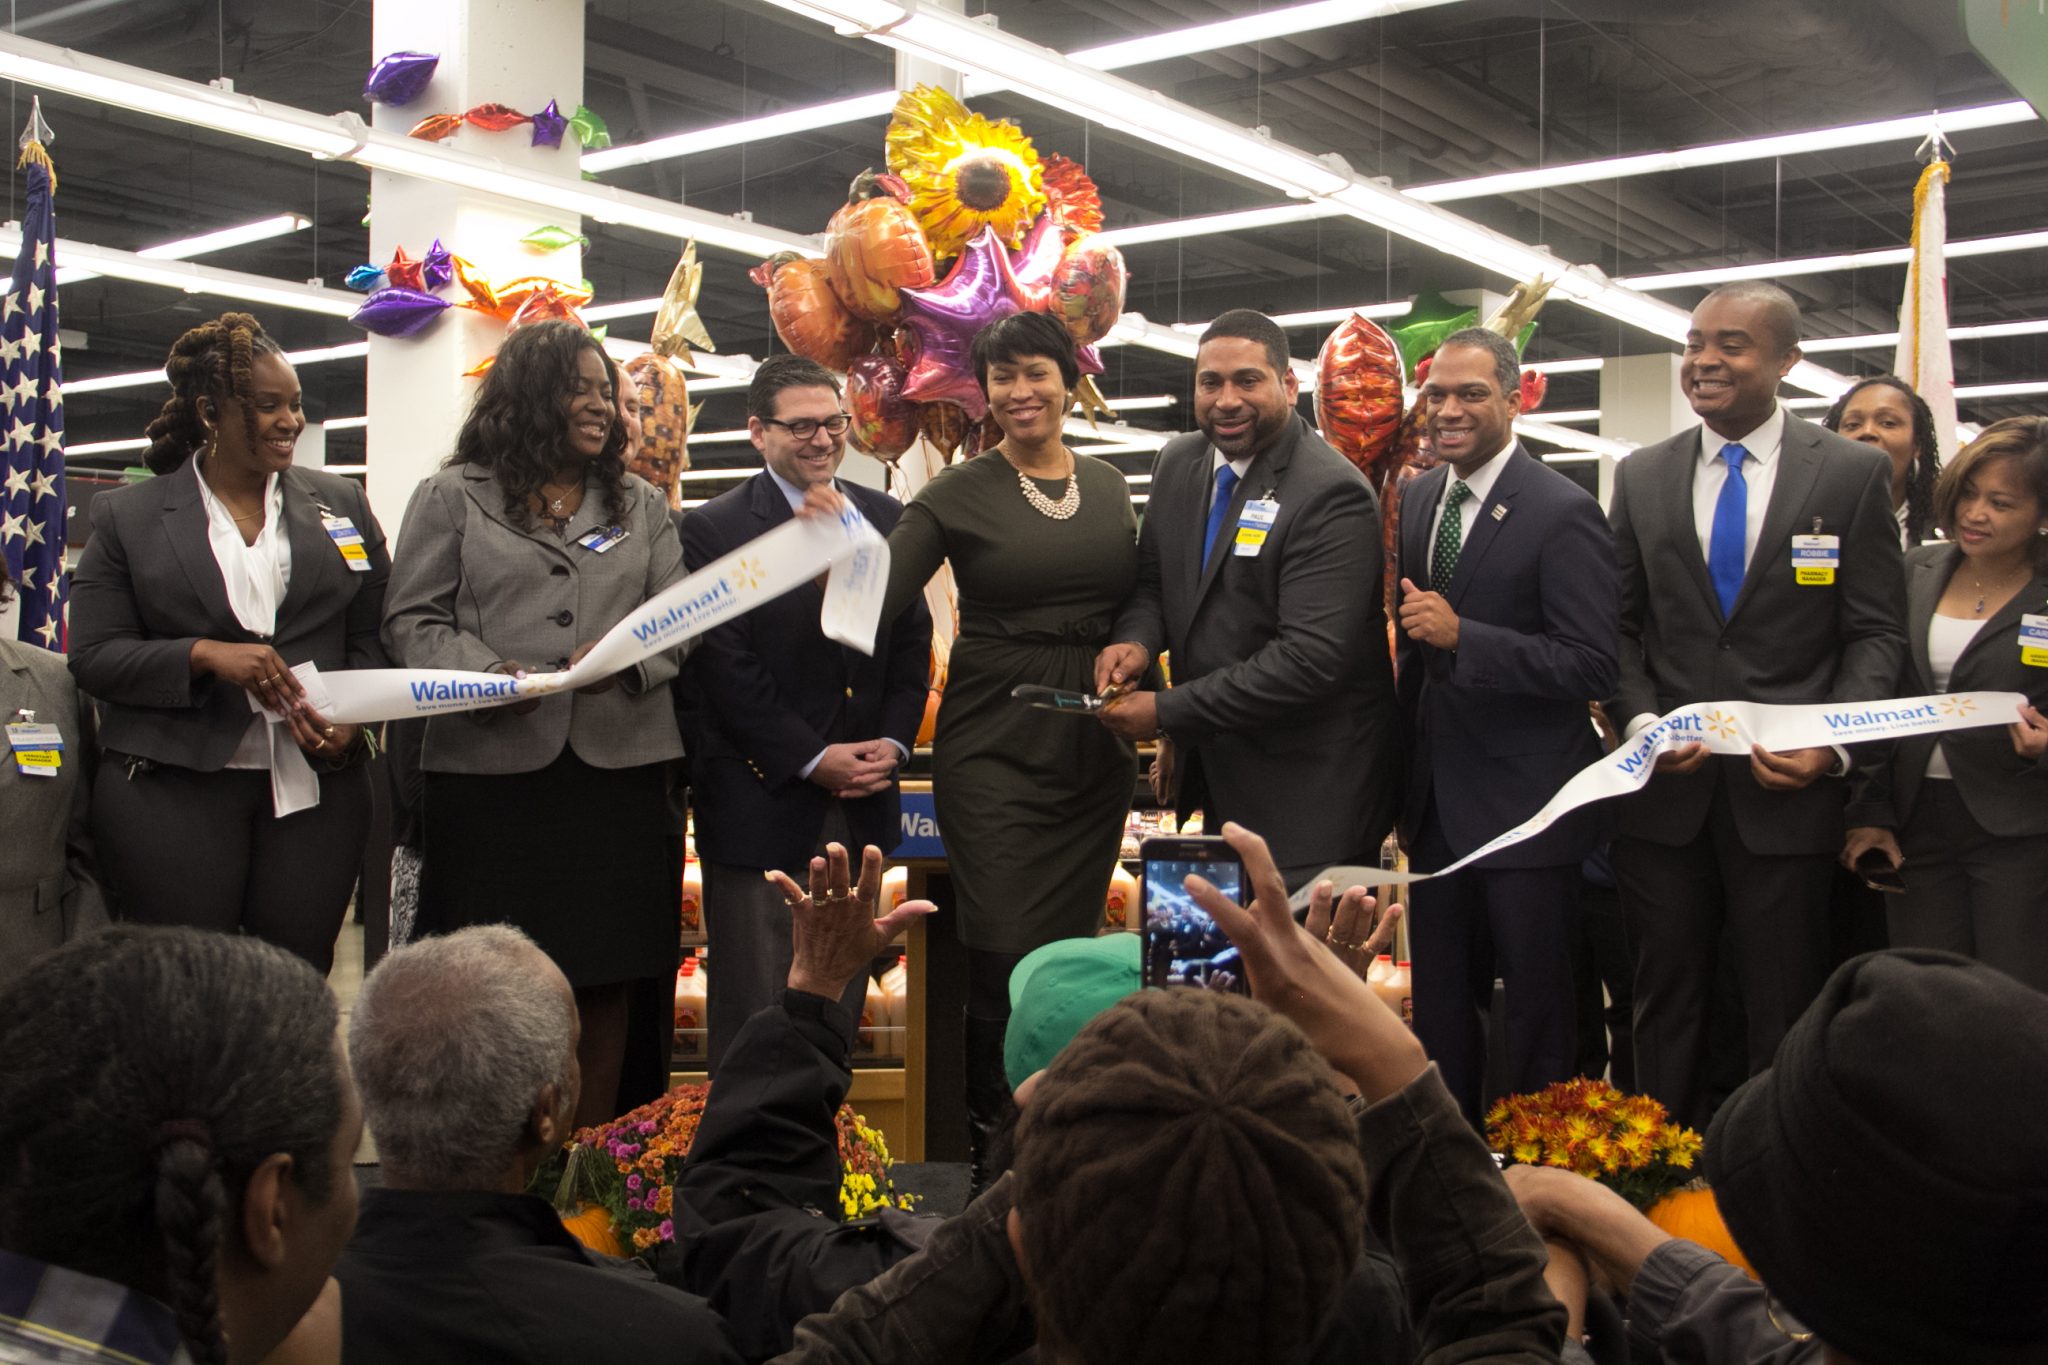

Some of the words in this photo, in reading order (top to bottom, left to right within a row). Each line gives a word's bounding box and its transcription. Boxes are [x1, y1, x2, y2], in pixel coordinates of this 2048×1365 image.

[1800, 549, 1829, 558] ROBBIE
[632, 575, 731, 642] Walmart
[410, 679, 520, 702] Walmart
[1824, 704, 1937, 728] Walmart
[1616, 712, 1703, 774] Walmart
[1832, 729, 1853, 737] Save
